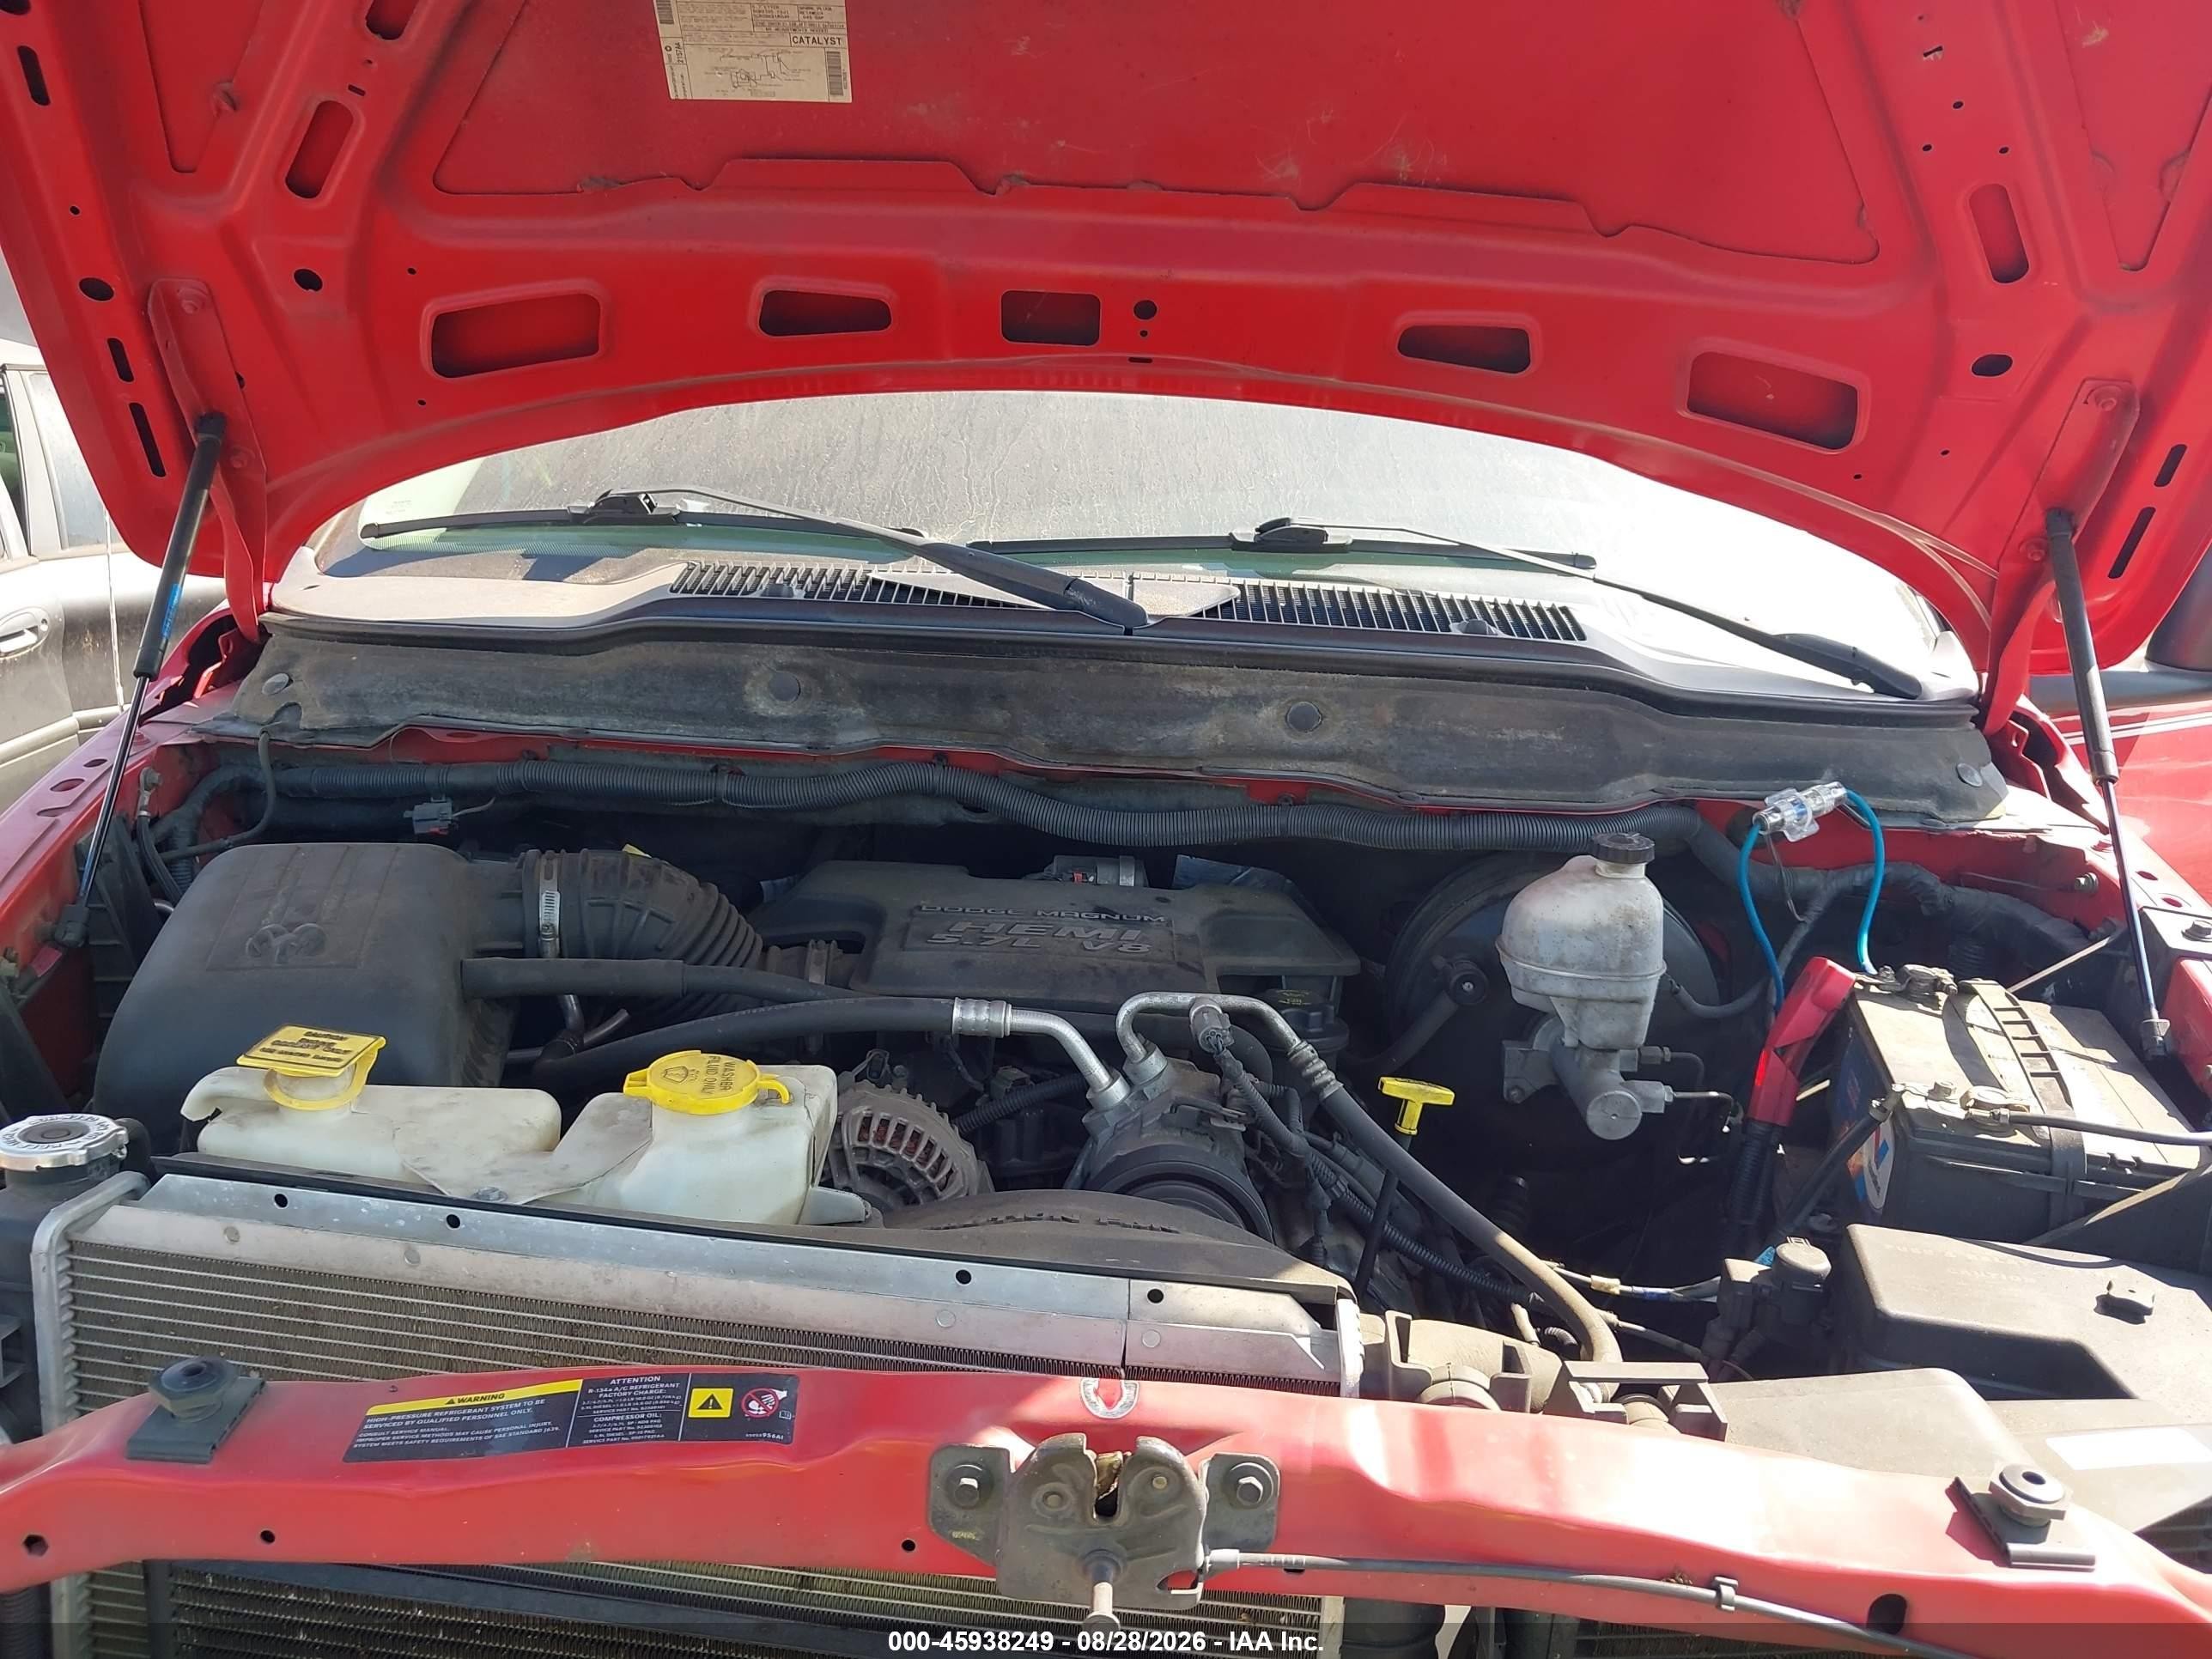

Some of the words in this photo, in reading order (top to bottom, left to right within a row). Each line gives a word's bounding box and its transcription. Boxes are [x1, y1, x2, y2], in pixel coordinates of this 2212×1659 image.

[793, 36, 842, 46] CATALYST
[921, 905, 1024, 915] DODGE
[1036, 909, 1165, 922] MAGNUM
[948, 921, 1141, 940] HEMI
[927, 933, 1042, 948] 5.7L
[1081, 940, 1152, 953] V8
[707, 1055, 722, 1075] FLUID
[720, 1061, 736, 1091] WASHER
[700, 1077, 717, 1095] ONLY
[610, 1376, 661, 1385] ATTENTION
[457, 1393, 505, 1404] WARNING
[362, 1419, 404, 1430] SERVICED
[416, 1415, 460, 1425] QUALIFIED
[461, 1411, 509, 1421] PERSONNEL
[366, 1411, 432, 1423] HIGH-PRESSURE
[434, 1407, 489, 1416] REFRIGERANT
[490, 1401, 521, 1412] SYSTEM
[593, 1413, 645, 1422] COMPRESSOR
[421, 1431, 453, 1439] METHODS
[494, 1425, 527, 1433] PERSONAL
[431, 1435, 483, 1443] REQUIREMENTS
[508, 1429, 543, 1437] STANDARD
